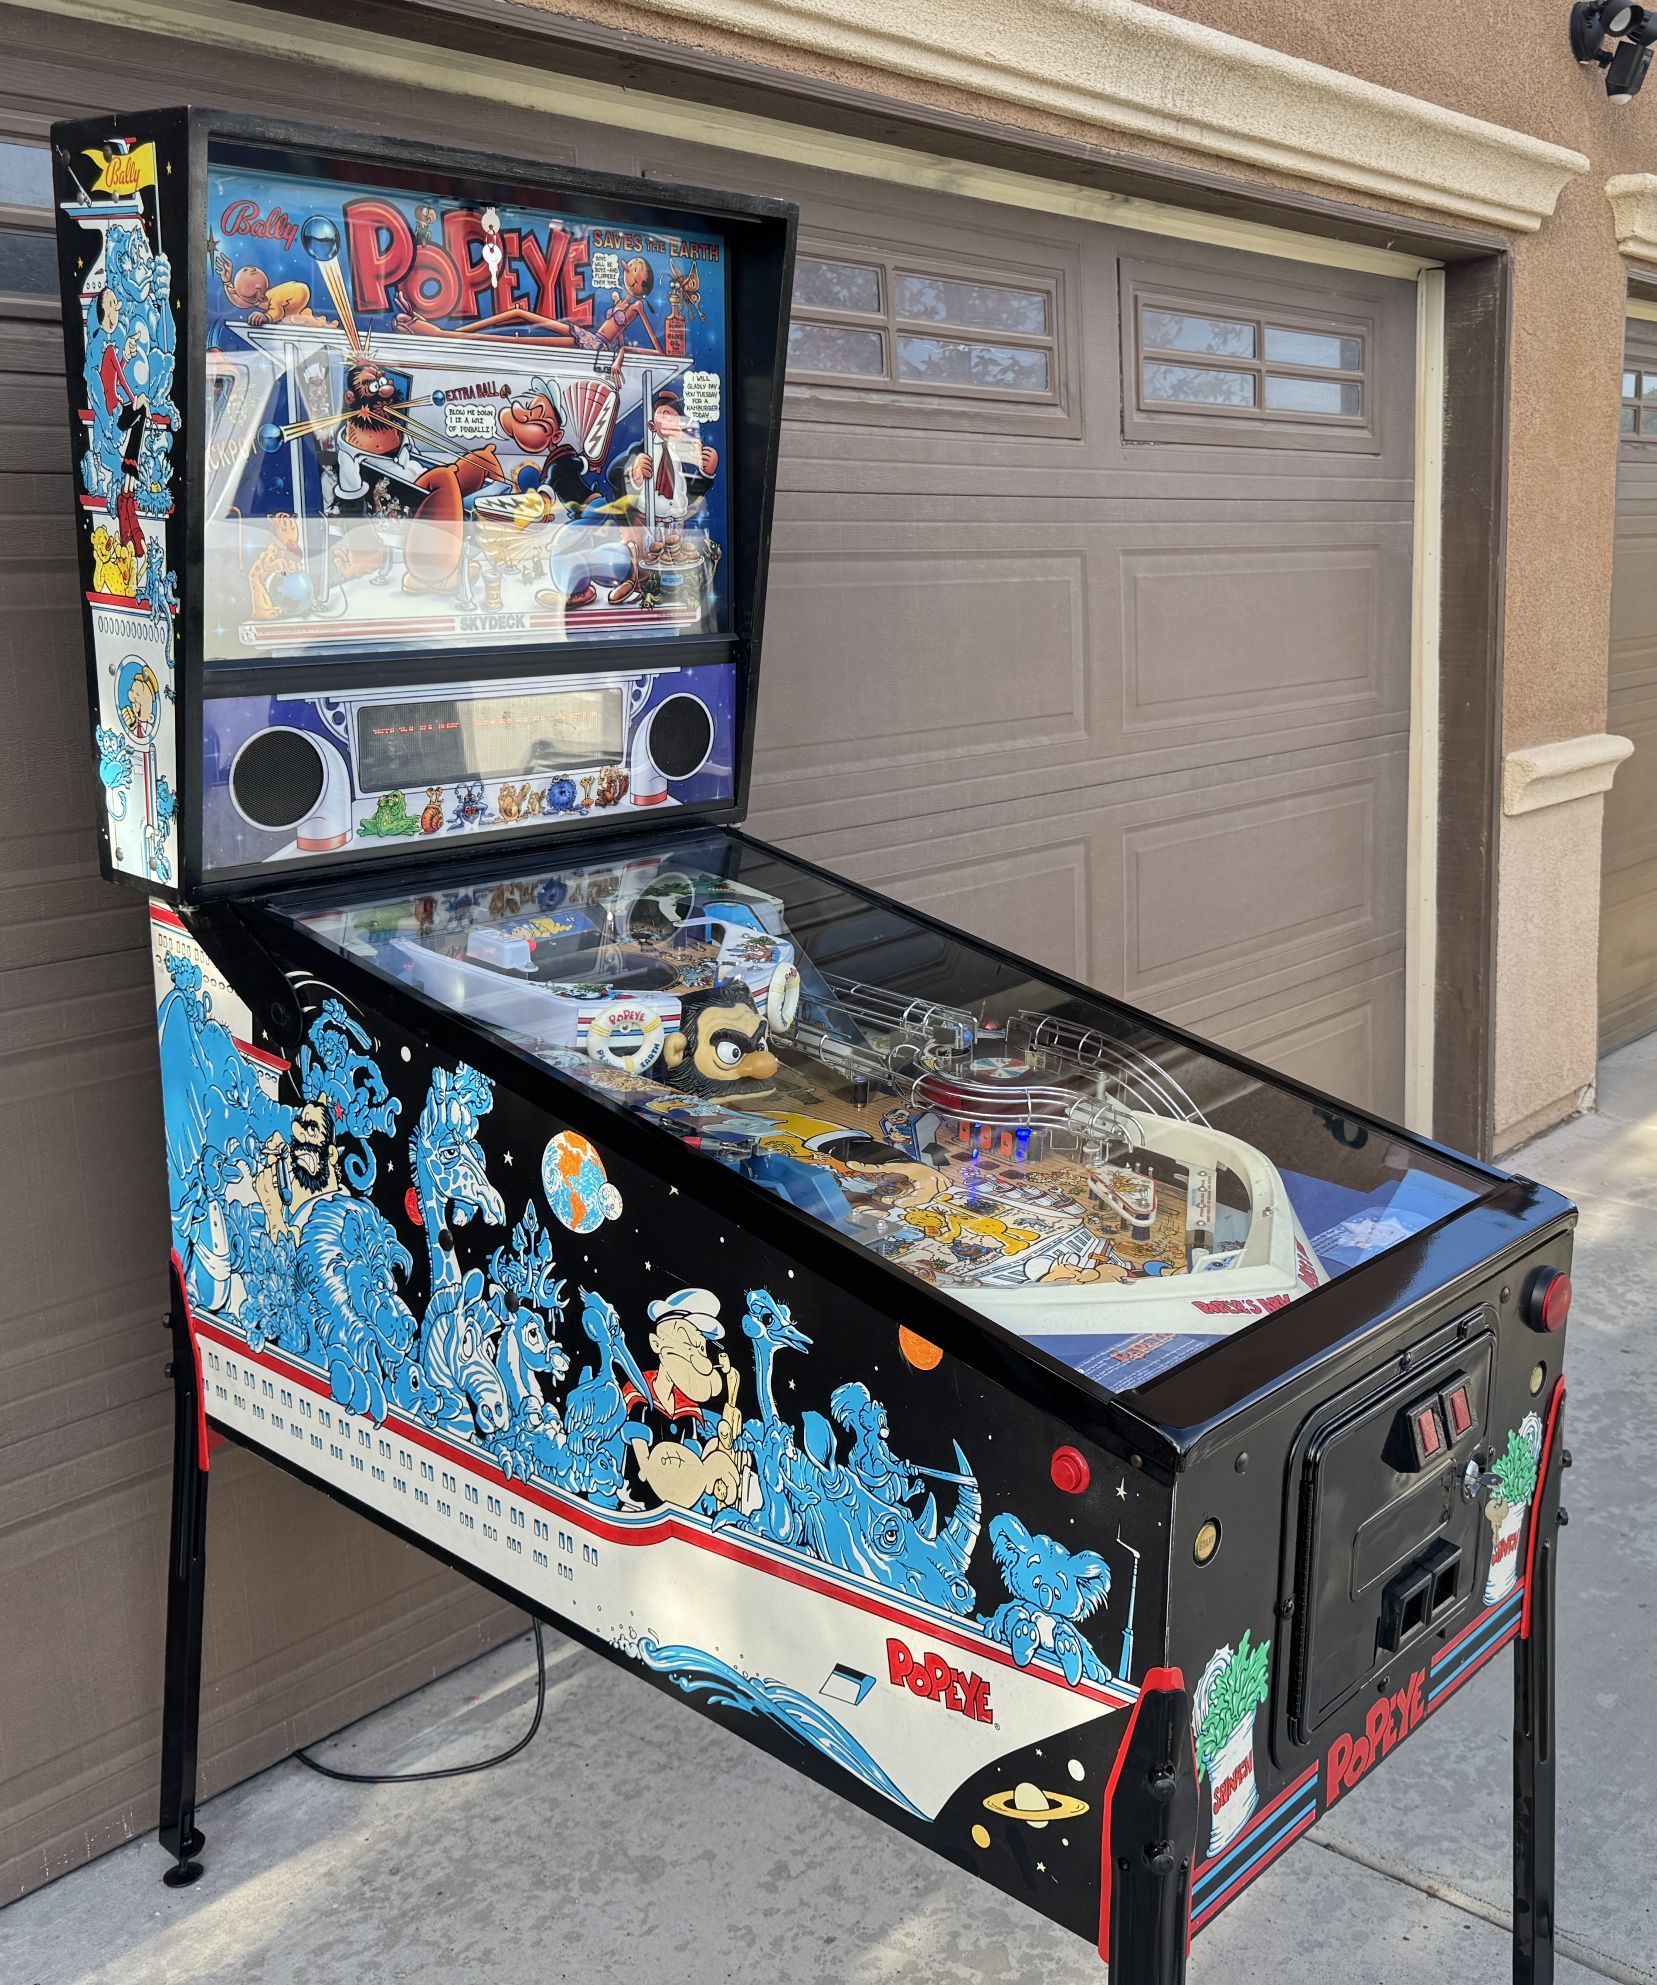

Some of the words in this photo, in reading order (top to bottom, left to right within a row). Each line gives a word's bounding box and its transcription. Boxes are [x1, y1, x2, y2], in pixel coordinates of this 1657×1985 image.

[105, 156, 141, 191] Bally
[220, 200, 299, 251] Bally
[343, 197, 593, 328] POPEYE
[592, 230, 643, 252] SAVES
[646, 239, 666, 253] THE
[669, 239, 719, 262] EARTH
[445, 384, 476, 401] EXTRA
[476, 381, 500, 398] BALL
[460, 614, 527, 632] SKYDECK
[608, 1009, 646, 1025] POPEYE
[640, 1043, 660, 1068] EARTH
[885, 1637, 993, 1724] POPEYE
[1326, 1667, 1426, 1807] POPEYE
[1212, 1749, 1253, 1815] SPINACH
